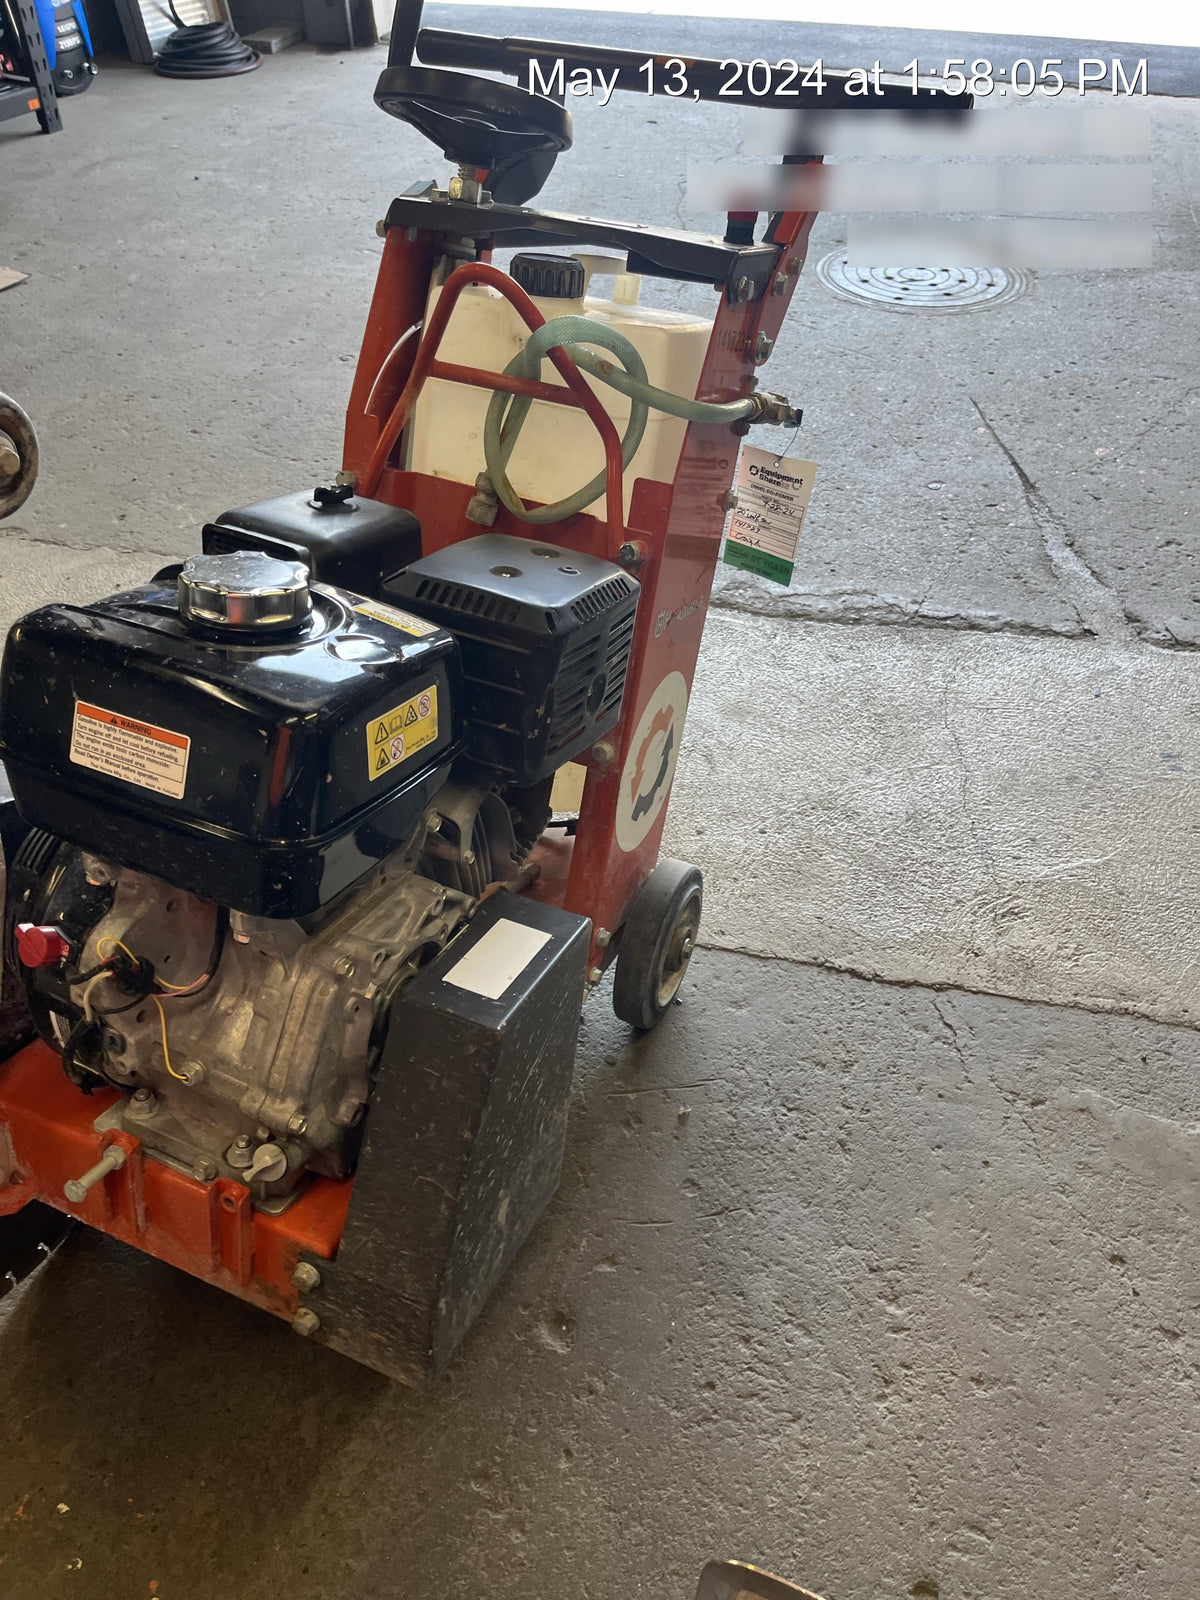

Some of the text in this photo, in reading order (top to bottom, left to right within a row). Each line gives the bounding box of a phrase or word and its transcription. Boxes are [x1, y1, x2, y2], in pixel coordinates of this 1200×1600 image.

[759, 474, 782, 486] Share
[760, 466, 804, 484] Equipment
[121, 720, 151, 735] WARNING
